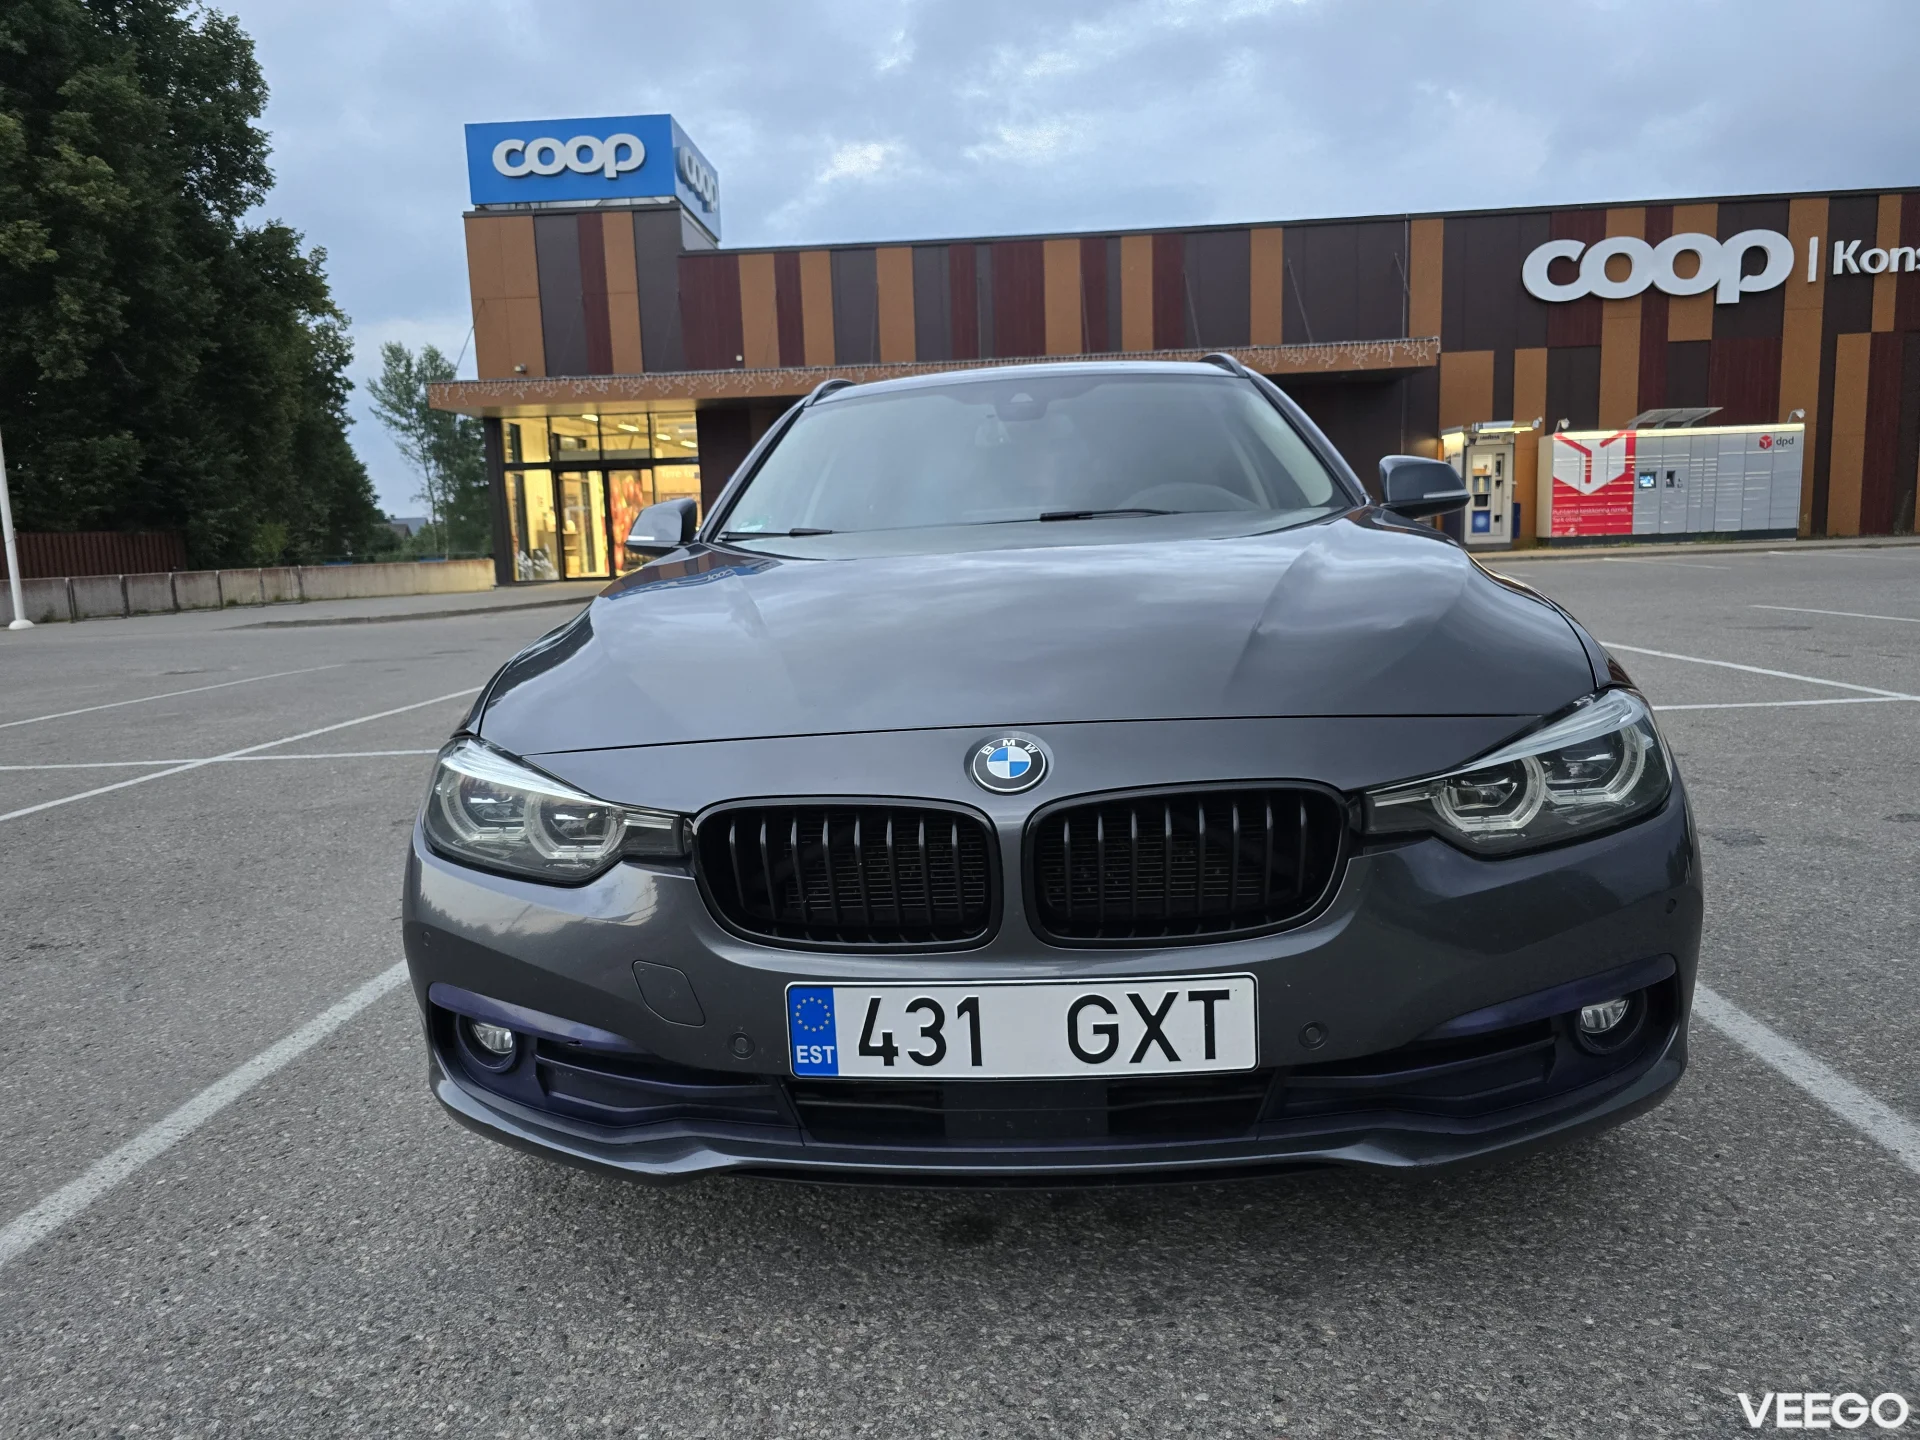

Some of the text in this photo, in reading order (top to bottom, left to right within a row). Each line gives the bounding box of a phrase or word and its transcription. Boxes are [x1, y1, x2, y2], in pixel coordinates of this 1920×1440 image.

[492, 133, 646, 178] coop
[678, 146, 718, 213] coop
[1521, 228, 1920, 304] coop Kon
[1775, 435, 1795, 448] dpd
[981, 739, 1039, 755] BMW
[858, 989, 1231, 1066] 431 GXT
[796, 1045, 835, 1064] EST
